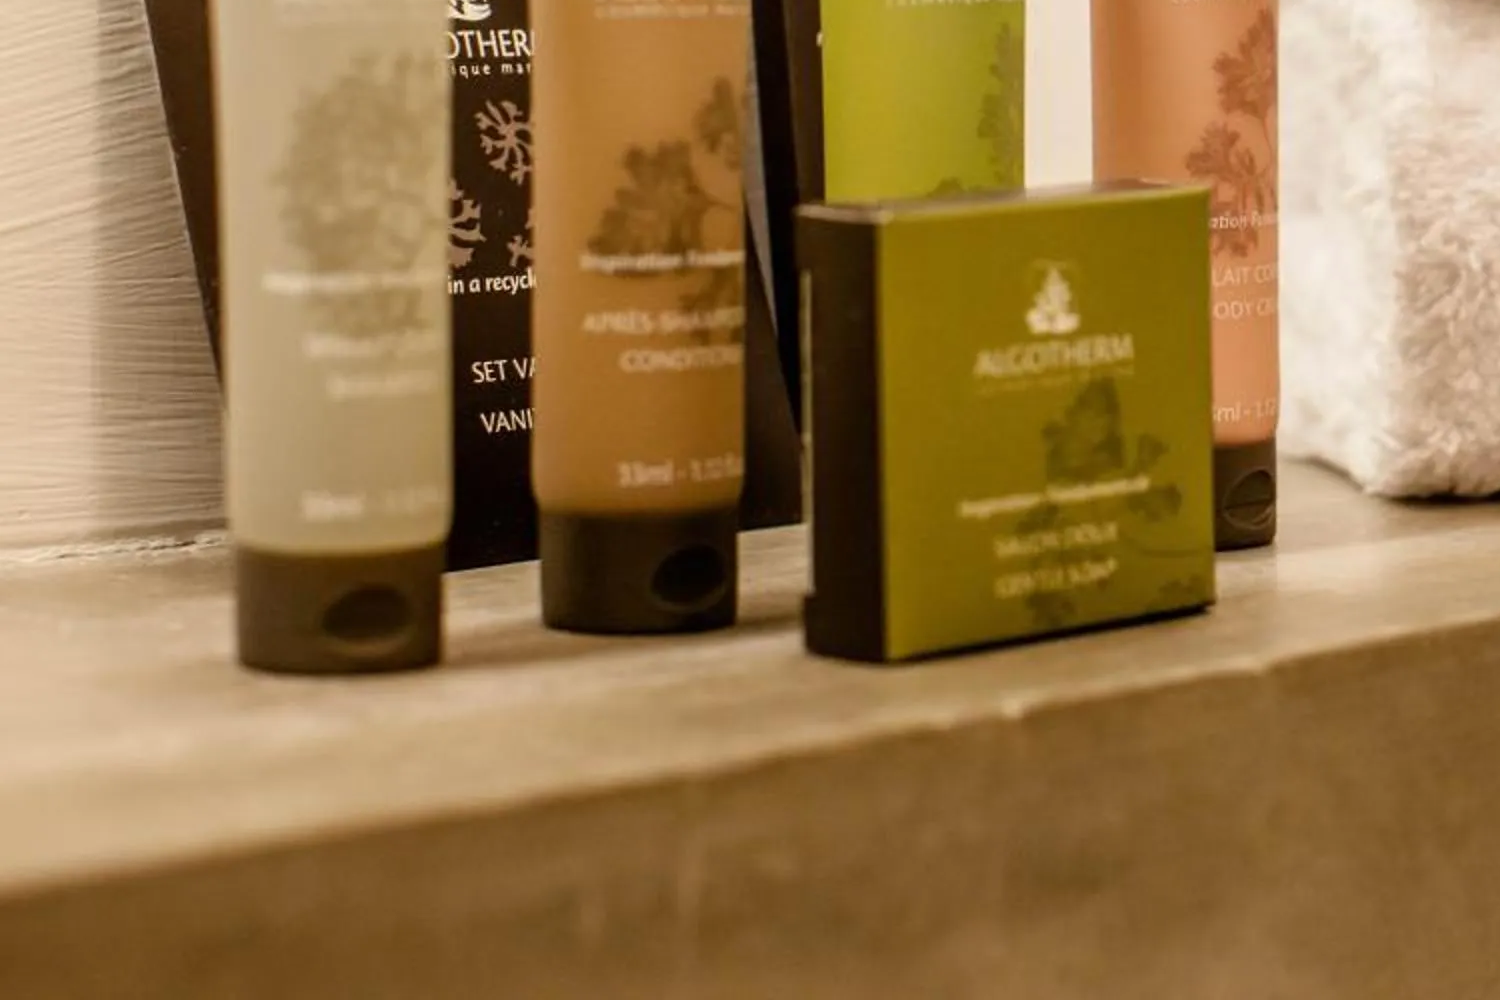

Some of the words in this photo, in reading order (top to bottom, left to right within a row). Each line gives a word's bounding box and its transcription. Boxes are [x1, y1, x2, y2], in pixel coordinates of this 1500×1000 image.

[469, 278, 481, 293] a
[1212, 299, 1251, 320] ODY
[472, 359, 508, 384] SET
[480, 408, 536, 434] VANI
